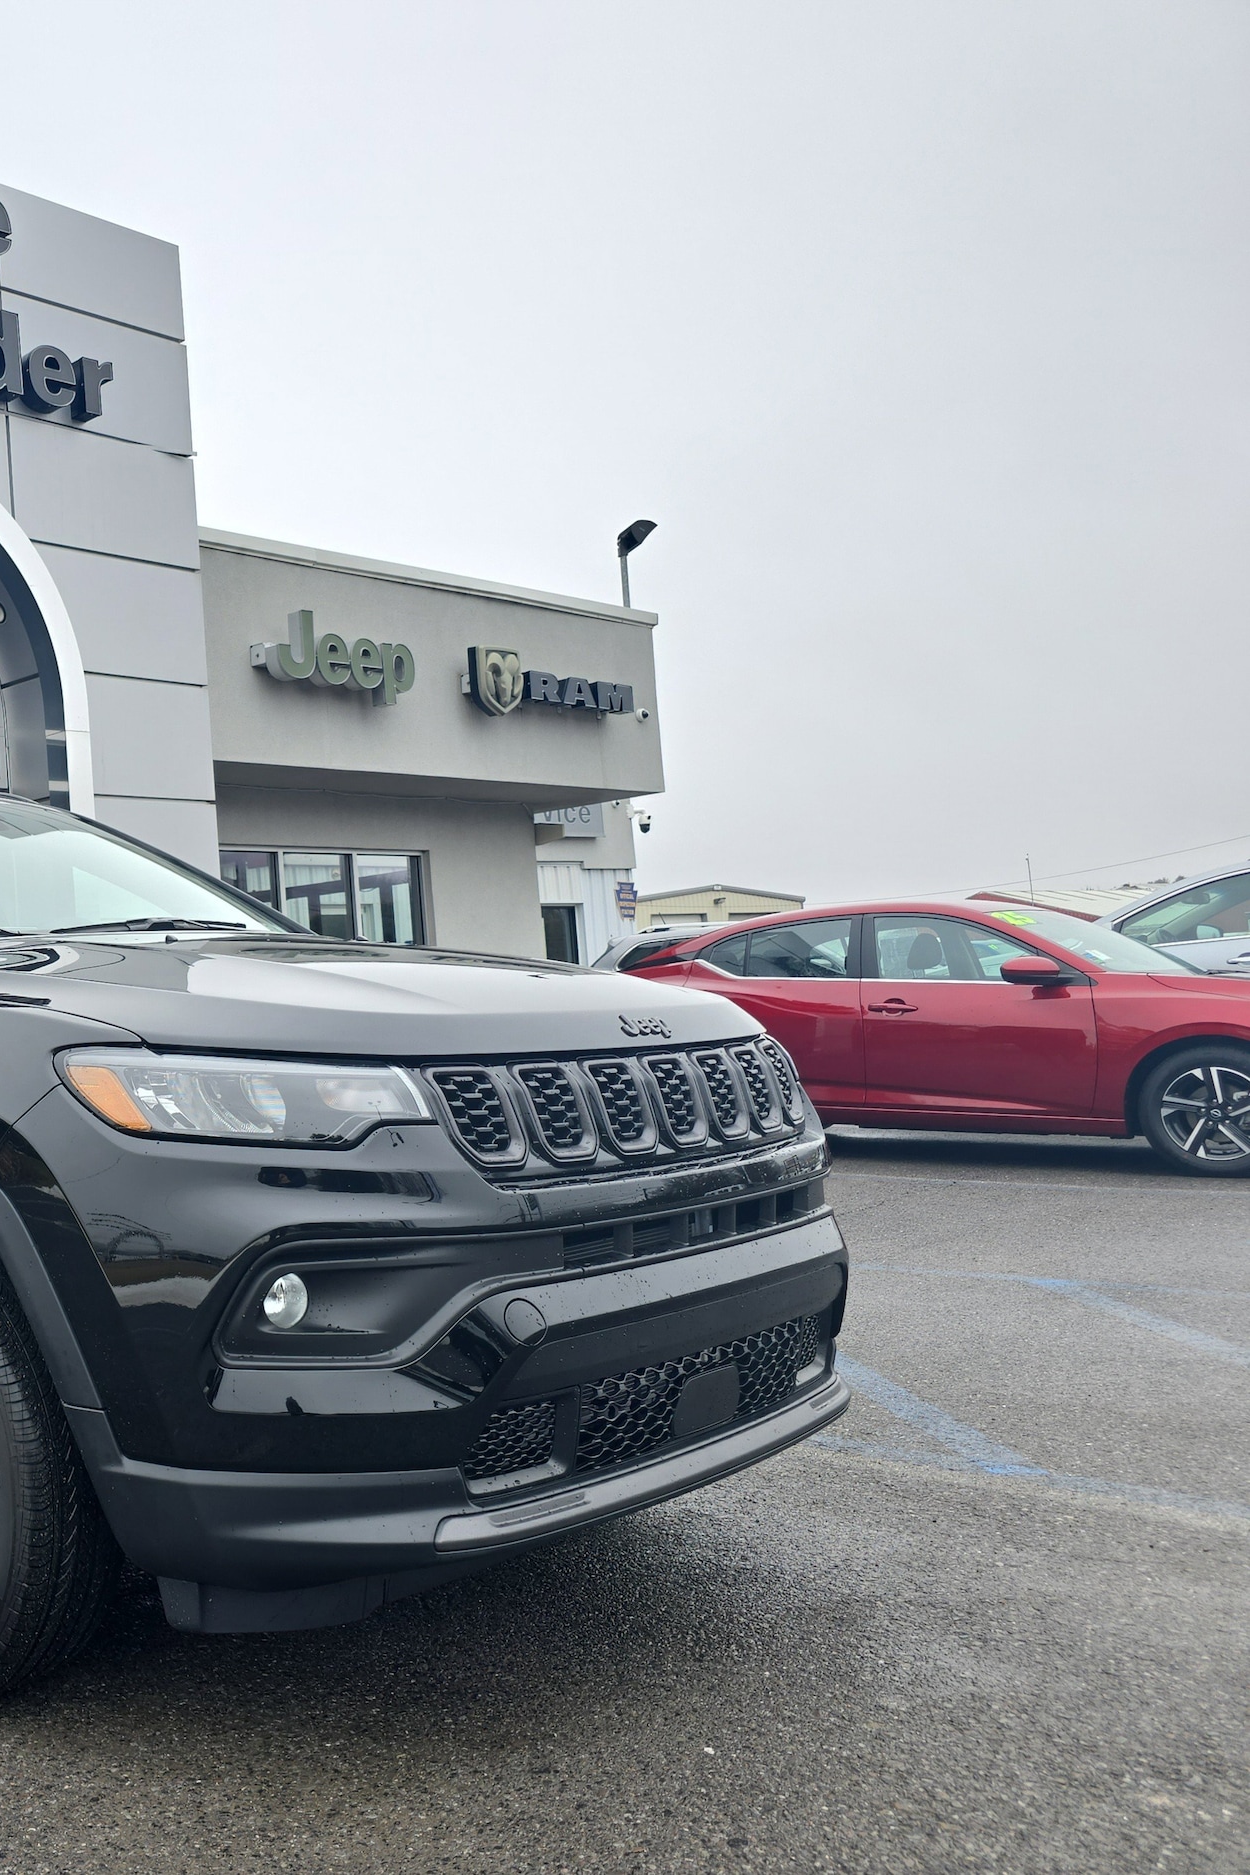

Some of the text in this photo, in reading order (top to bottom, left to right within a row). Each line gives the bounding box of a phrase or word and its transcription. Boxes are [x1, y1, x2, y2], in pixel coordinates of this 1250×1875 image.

[266, 609, 415, 707] Jeep
[524, 670, 634, 714] RAM
[618, 1014, 672, 1039] Jeep
